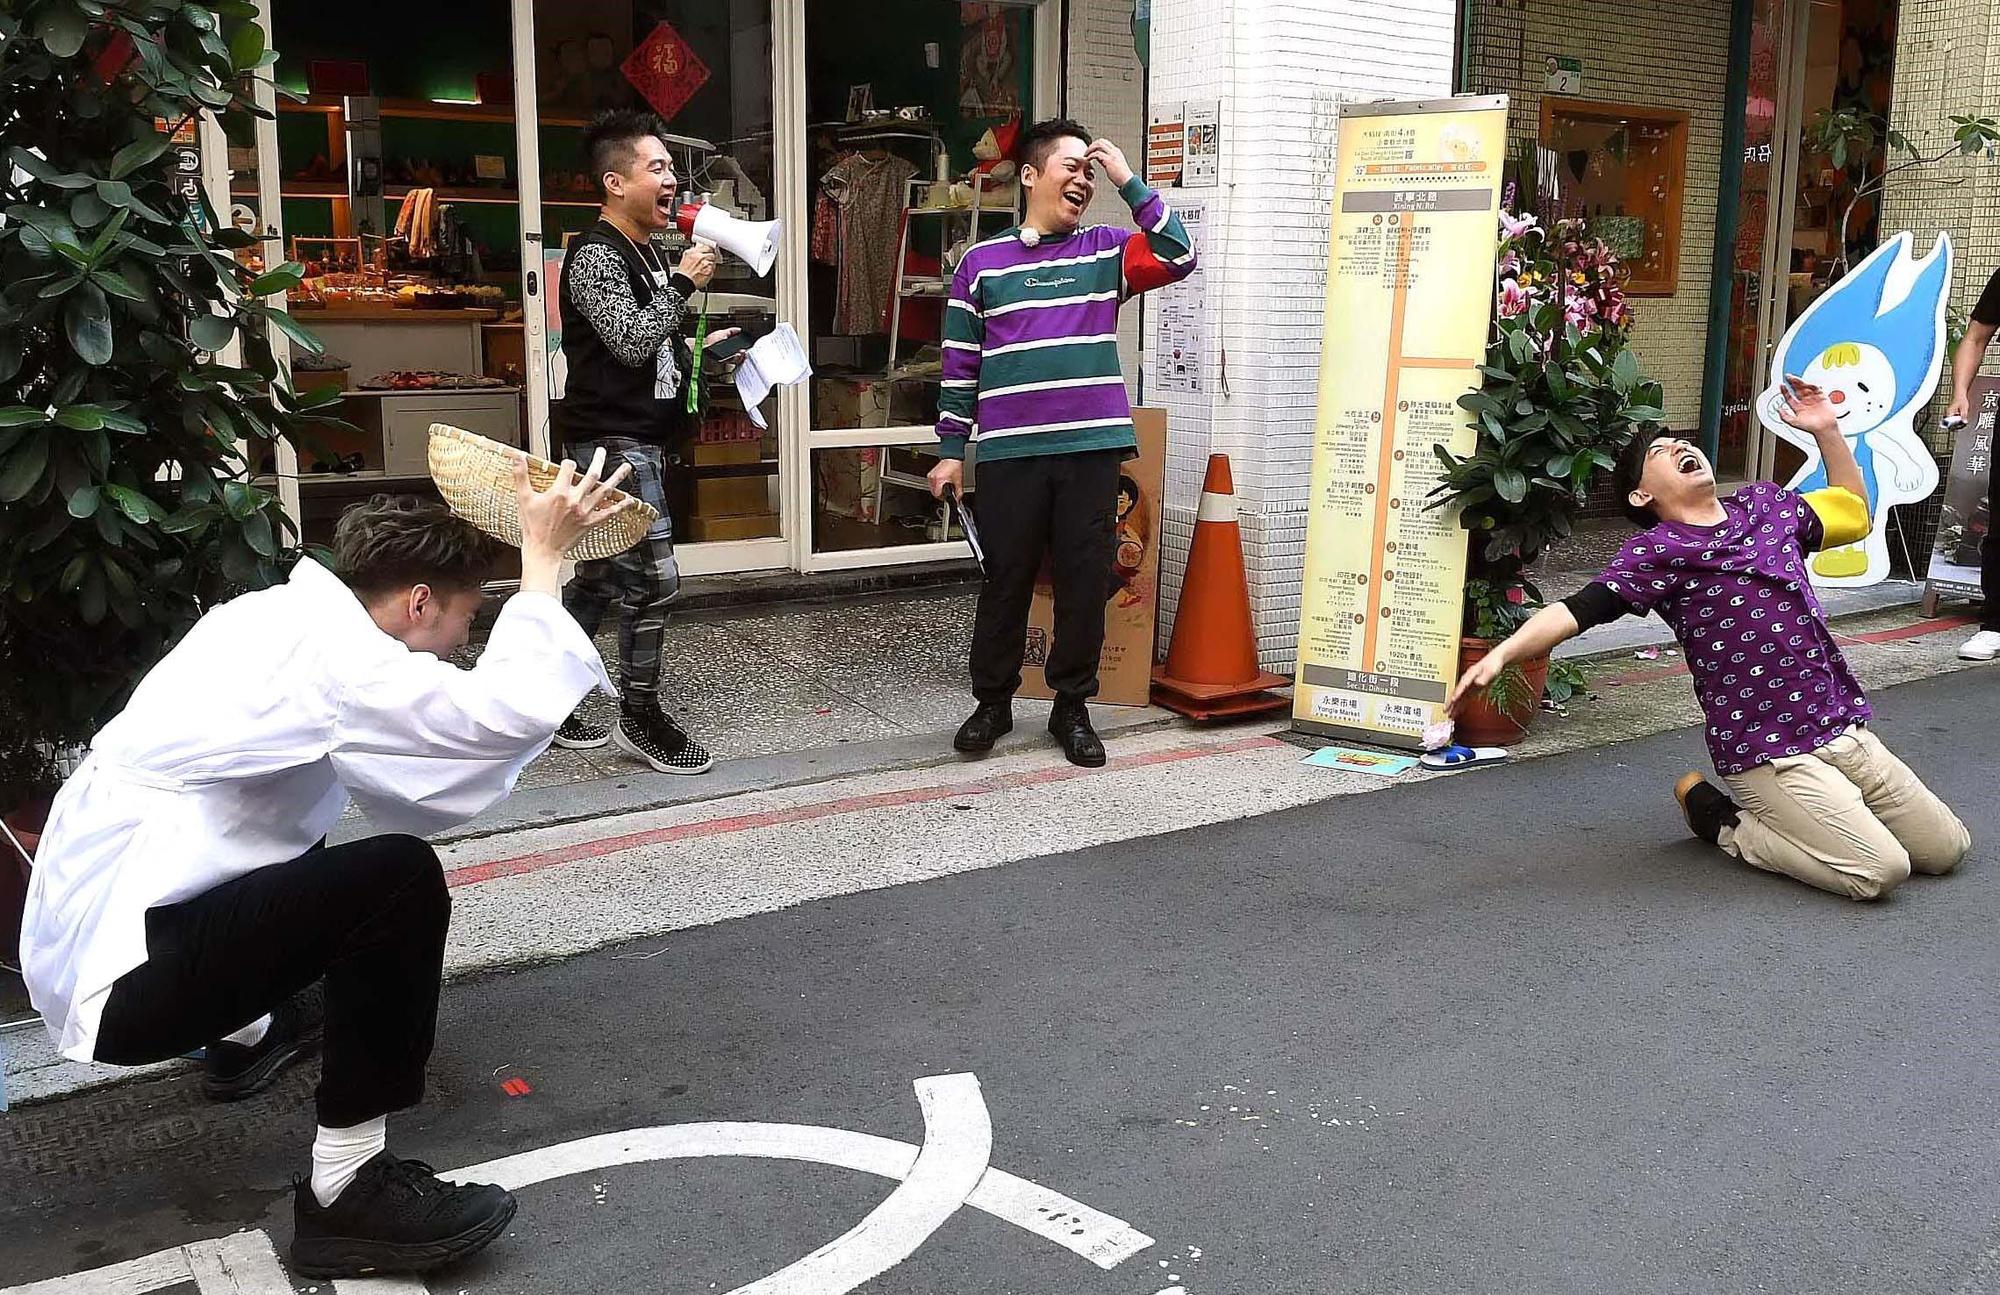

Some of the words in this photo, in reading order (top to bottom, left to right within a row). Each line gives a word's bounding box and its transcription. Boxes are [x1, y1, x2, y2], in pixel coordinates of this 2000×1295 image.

[652, 42, 679, 74] 福
[1560, 77, 1567, 91] 2
[1322, 695, 1358, 709] 永樂市場
[1339, 708, 1360, 717] Market
[1402, 717, 1425, 727] square
